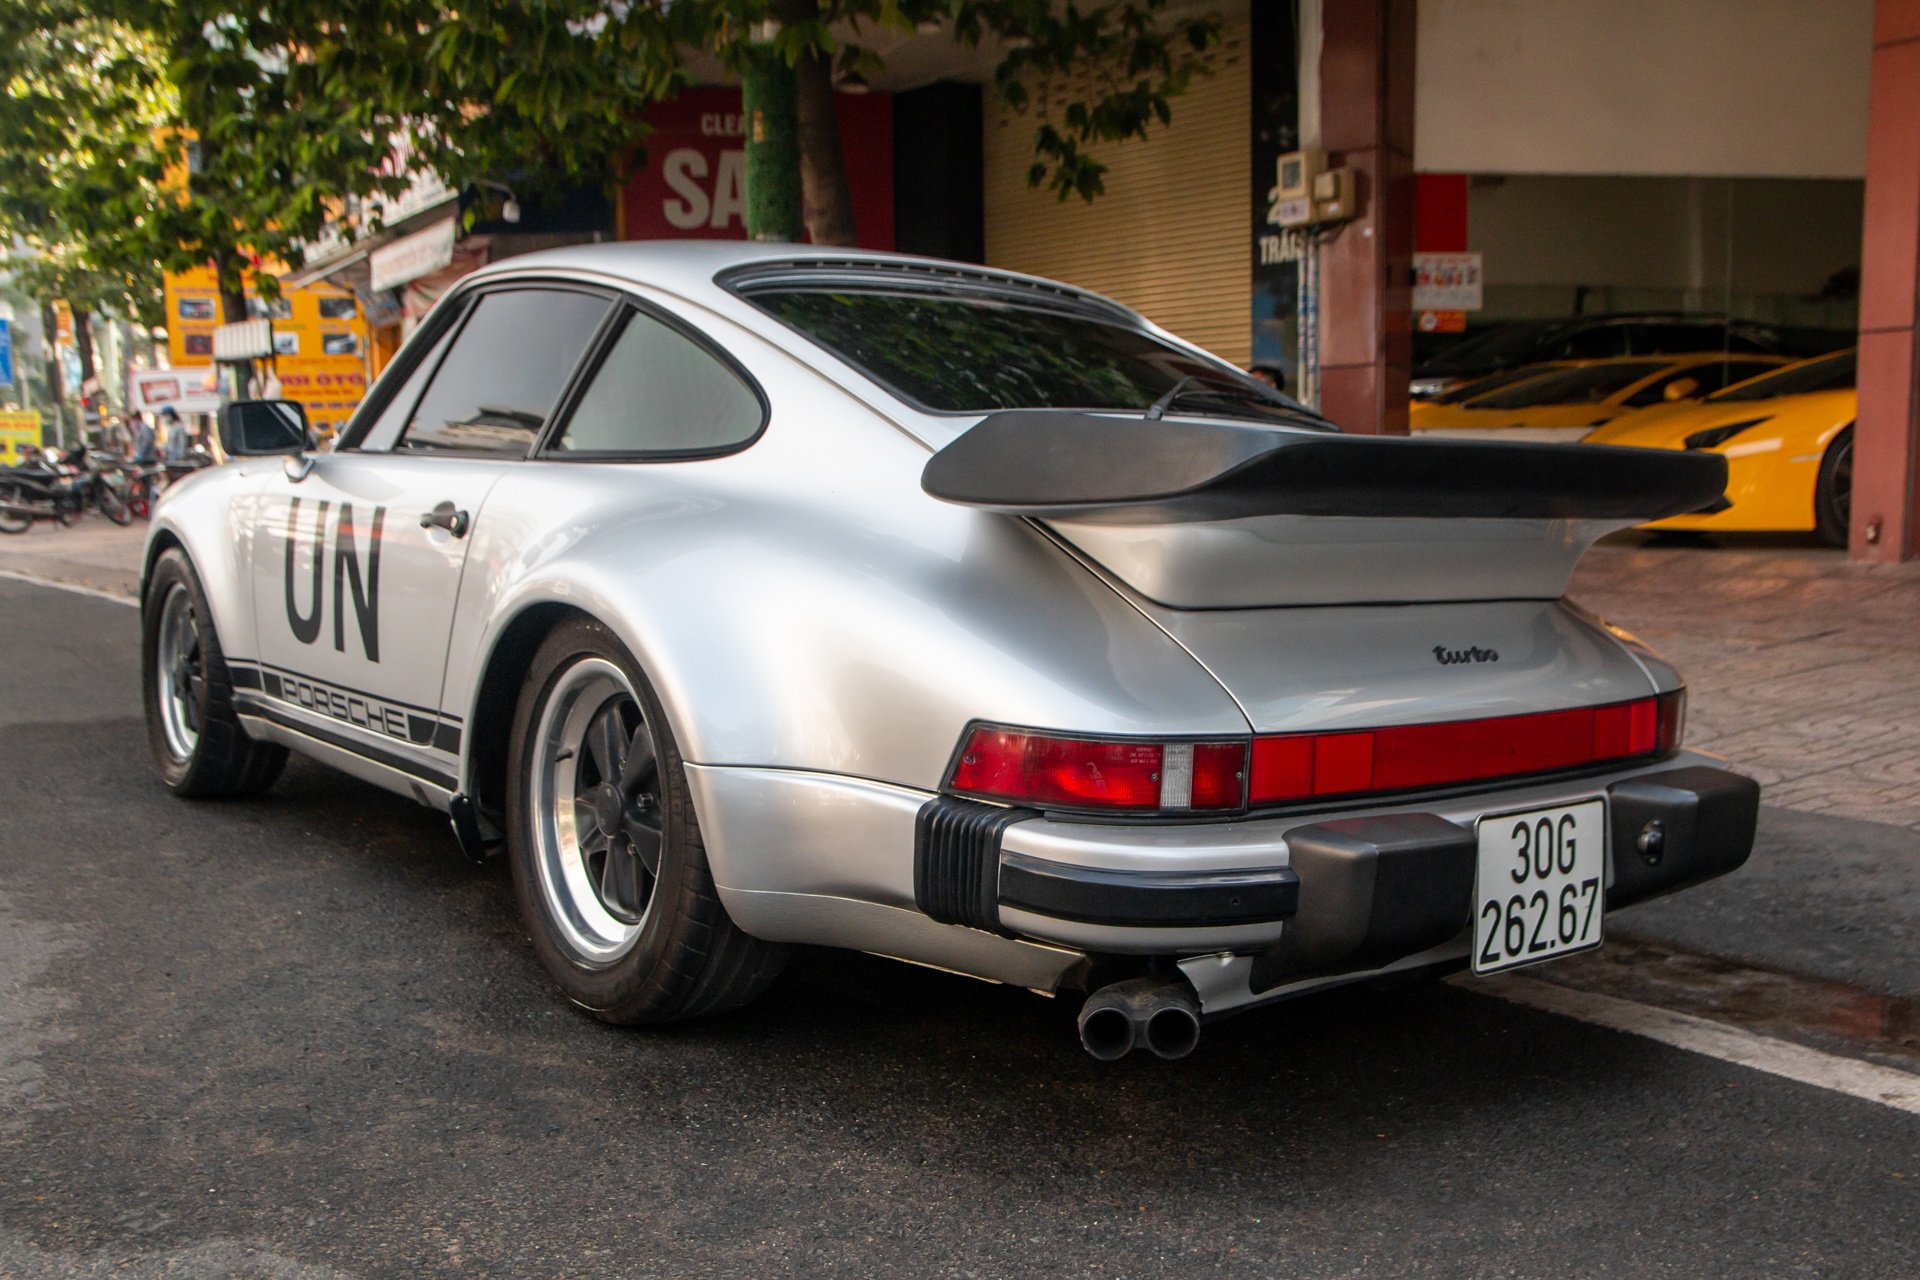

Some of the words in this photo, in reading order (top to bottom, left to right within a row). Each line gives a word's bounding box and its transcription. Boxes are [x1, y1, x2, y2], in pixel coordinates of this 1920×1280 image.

[284, 496, 387, 664] UN
[1432, 644, 1500, 666] turbo
[281, 677, 408, 740] PORSCHE
[1510, 813, 1578, 884] 30G
[1479, 877, 1599, 966] 262.67
